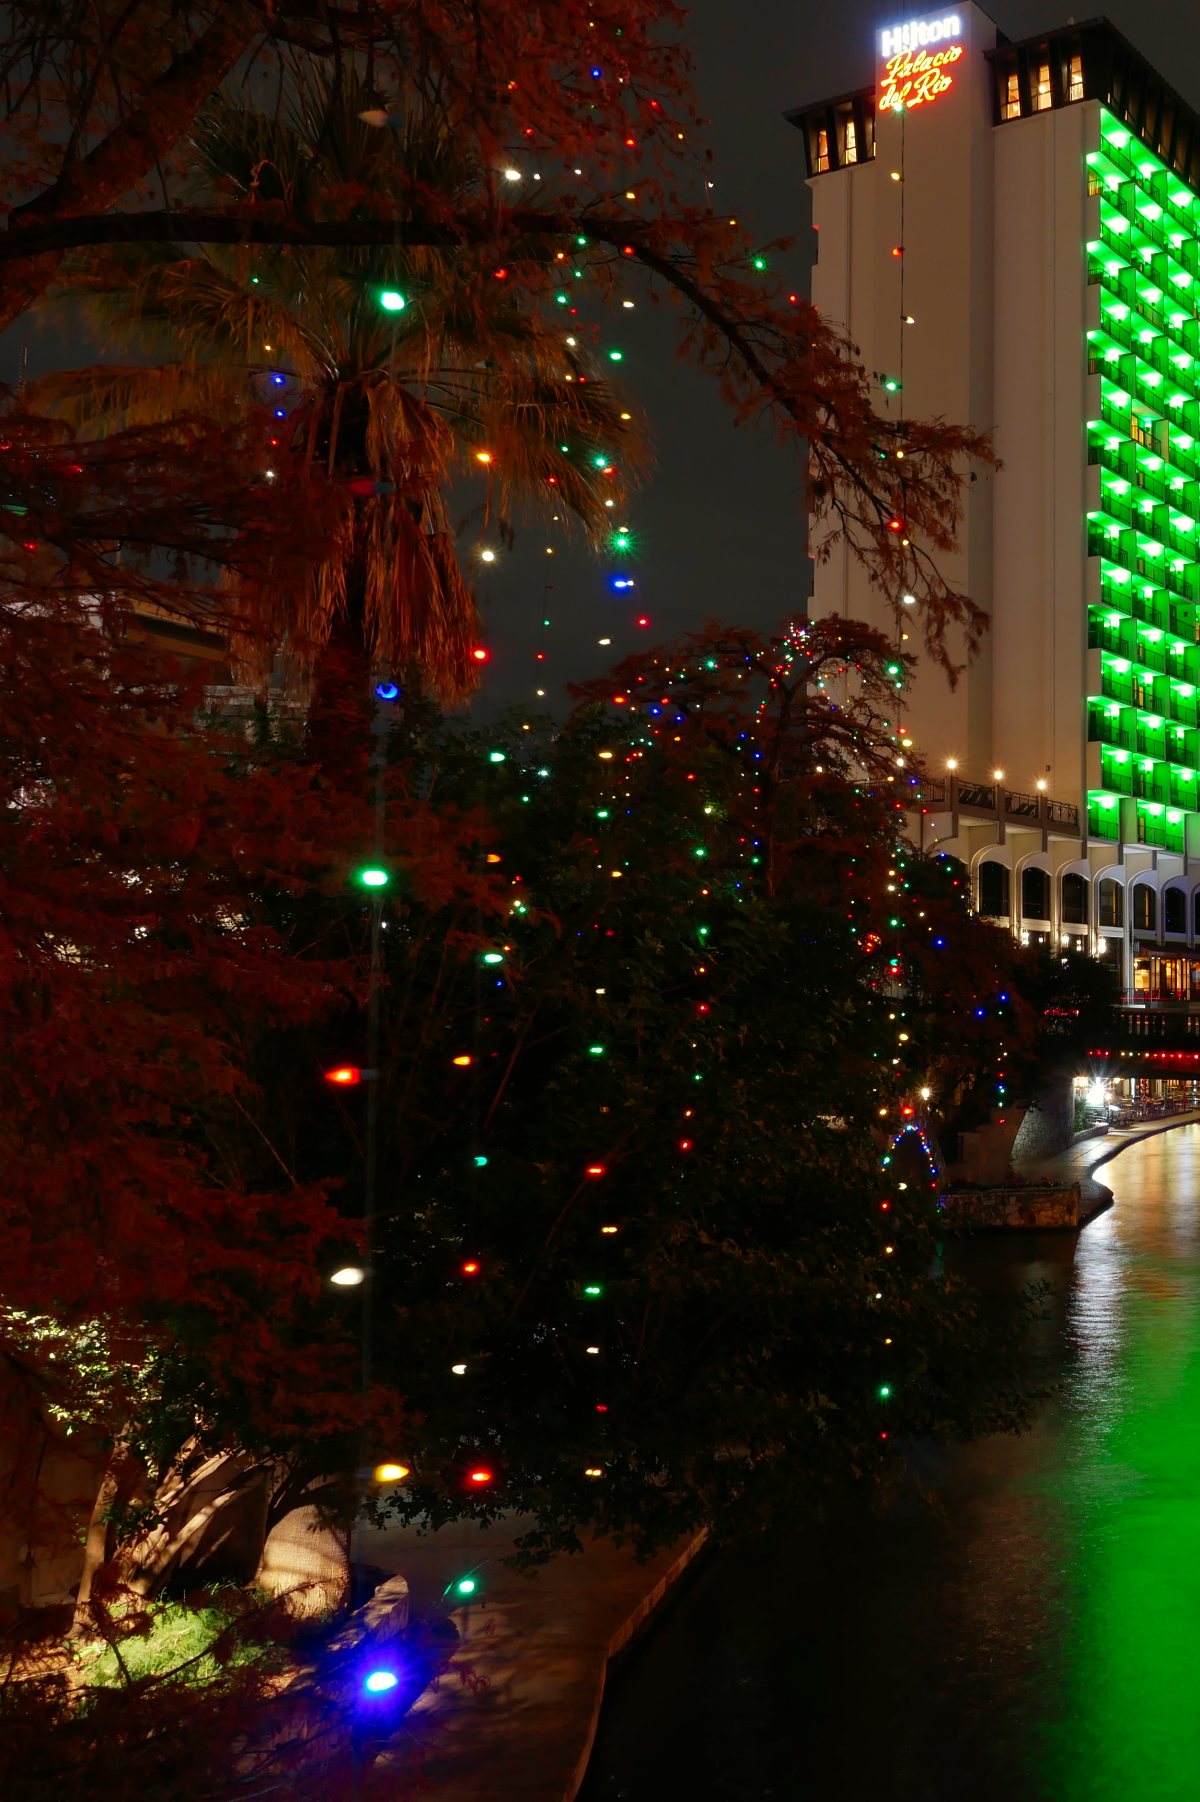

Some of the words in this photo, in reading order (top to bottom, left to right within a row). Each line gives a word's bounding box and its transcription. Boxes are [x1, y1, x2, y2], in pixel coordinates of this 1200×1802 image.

[881, 15, 960, 57] Hilton
[881, 45, 962, 87] Palacio
[879, 81, 912, 111] del
[906, 67, 952, 107] Rio
